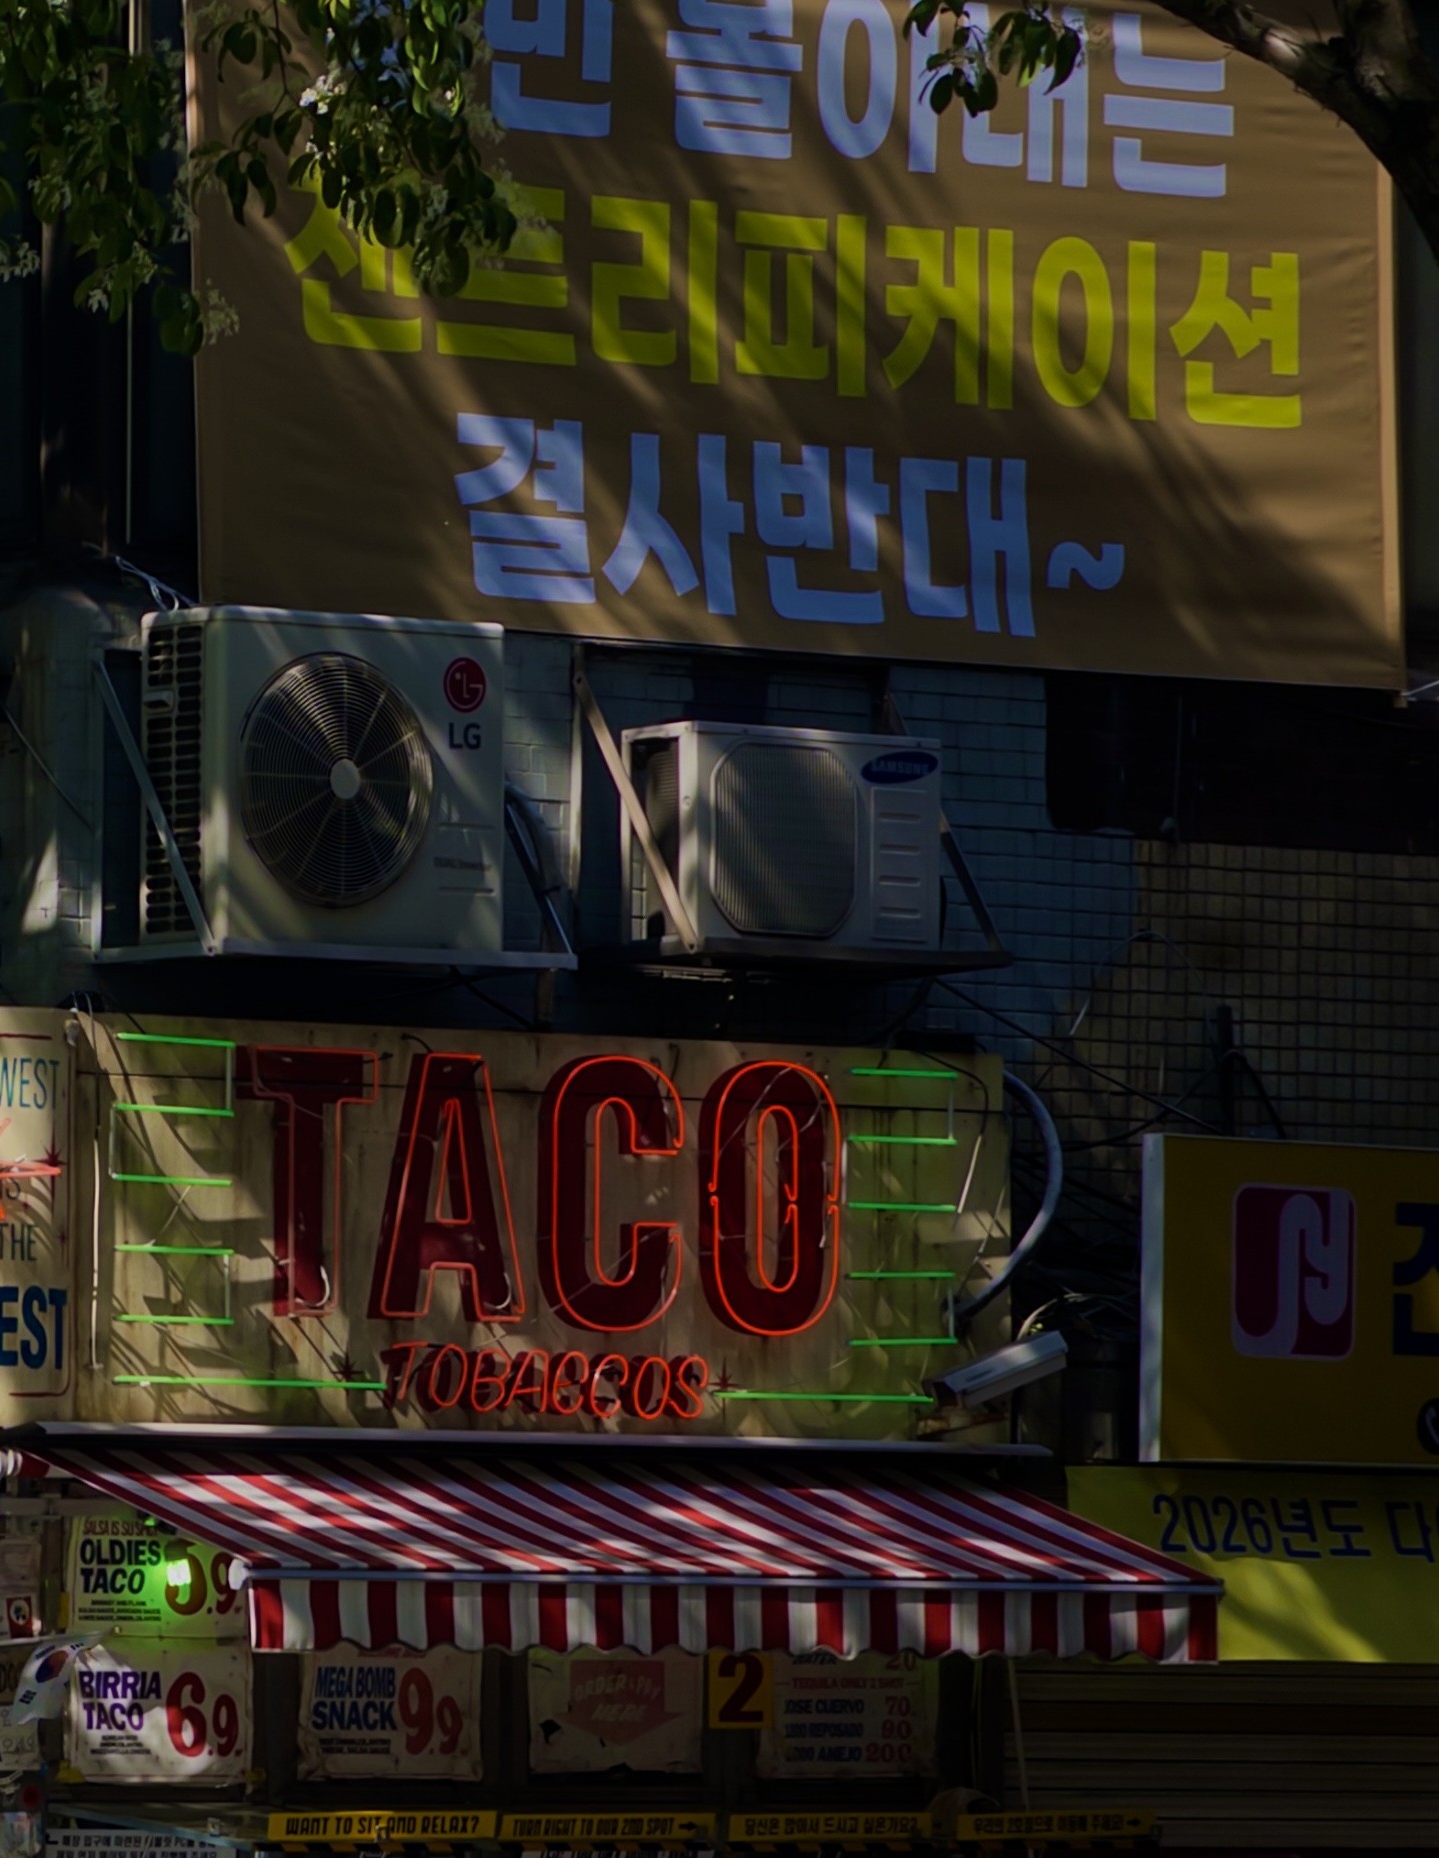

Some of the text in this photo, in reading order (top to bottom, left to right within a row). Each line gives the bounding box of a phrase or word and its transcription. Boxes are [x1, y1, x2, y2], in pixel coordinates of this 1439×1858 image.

[457, 412, 1127, 638] 결사반대~
[449, 722, 482, 751] LG
[869, 758, 930, 777] SAMSUNG
[236, 1045, 841, 1336] TACO
[1152, 1494, 1371, 1559] 2026년도
[80, 1538, 161, 1566] OLDIES
[81, 1567, 145, 1594] TACO
[575, 1673, 627, 1701] ORDER
[717, 1654, 764, 1723] 2
[78, 1670, 239, 1758] BIRRIA 6.9
[82, 1703, 144, 1731] TACO
[311, 1701, 398, 1731] SNACK
[315, 1667, 463, 1755] MEGA BOMB 9.9
[591, 1703, 648, 1722] HERE
[815, 1698, 865, 1714] CUERVO
[286, 1816, 329, 1836] WANT
[335, 1816, 353, 1835] TO
[386, 1815, 416, 1834] AND
[421, 1814, 480, 1834] RELAX?
[512, 1818, 542, 1837] TURN
[544, 1817, 577, 1837] RIGHT
[580, 1817, 594, 1836] TO
[647, 1817, 674, 1835] SPOT
[824, 1816, 858, 1835] 드시고
